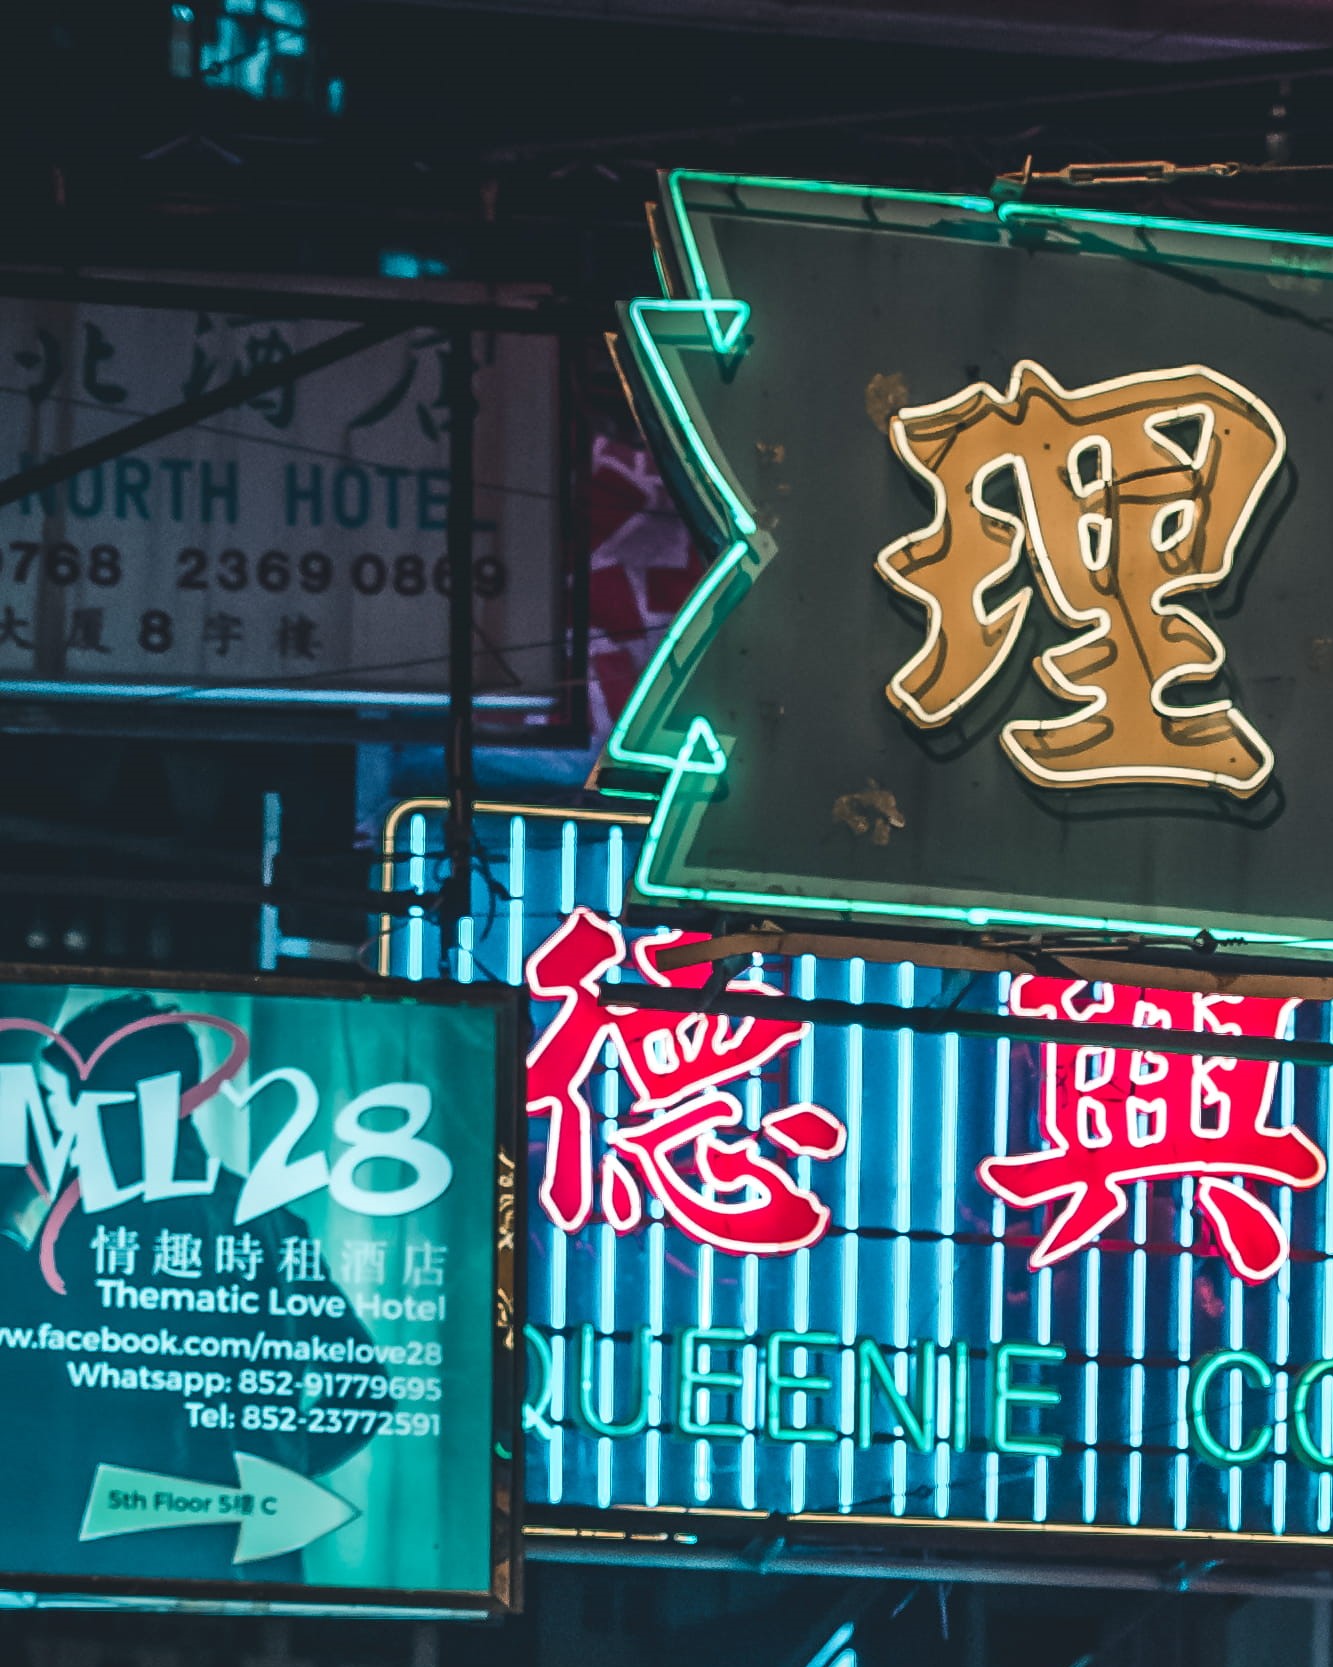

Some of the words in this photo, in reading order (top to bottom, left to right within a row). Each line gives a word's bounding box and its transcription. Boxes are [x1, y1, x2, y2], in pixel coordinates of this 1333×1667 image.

[0, 541, 121, 588] 768
[178, 548, 333, 594] 2369
[91, 1225, 448, 1288] 情趣時租酒店
[96, 1279, 260, 1315] Thematic
[268, 1283, 345, 1319] Love
[358, 1294, 446, 1322] Hotel
[67, 1361, 232, 1397] Whatsapp:
[238, 1369, 442, 1401] 852-91779695
[186, 1402, 235, 1431] Tel:
[242, 1405, 440, 1437] 852-23772591
[108, 1489, 147, 1511] 5th
[154, 1491, 211, 1513] Floor
